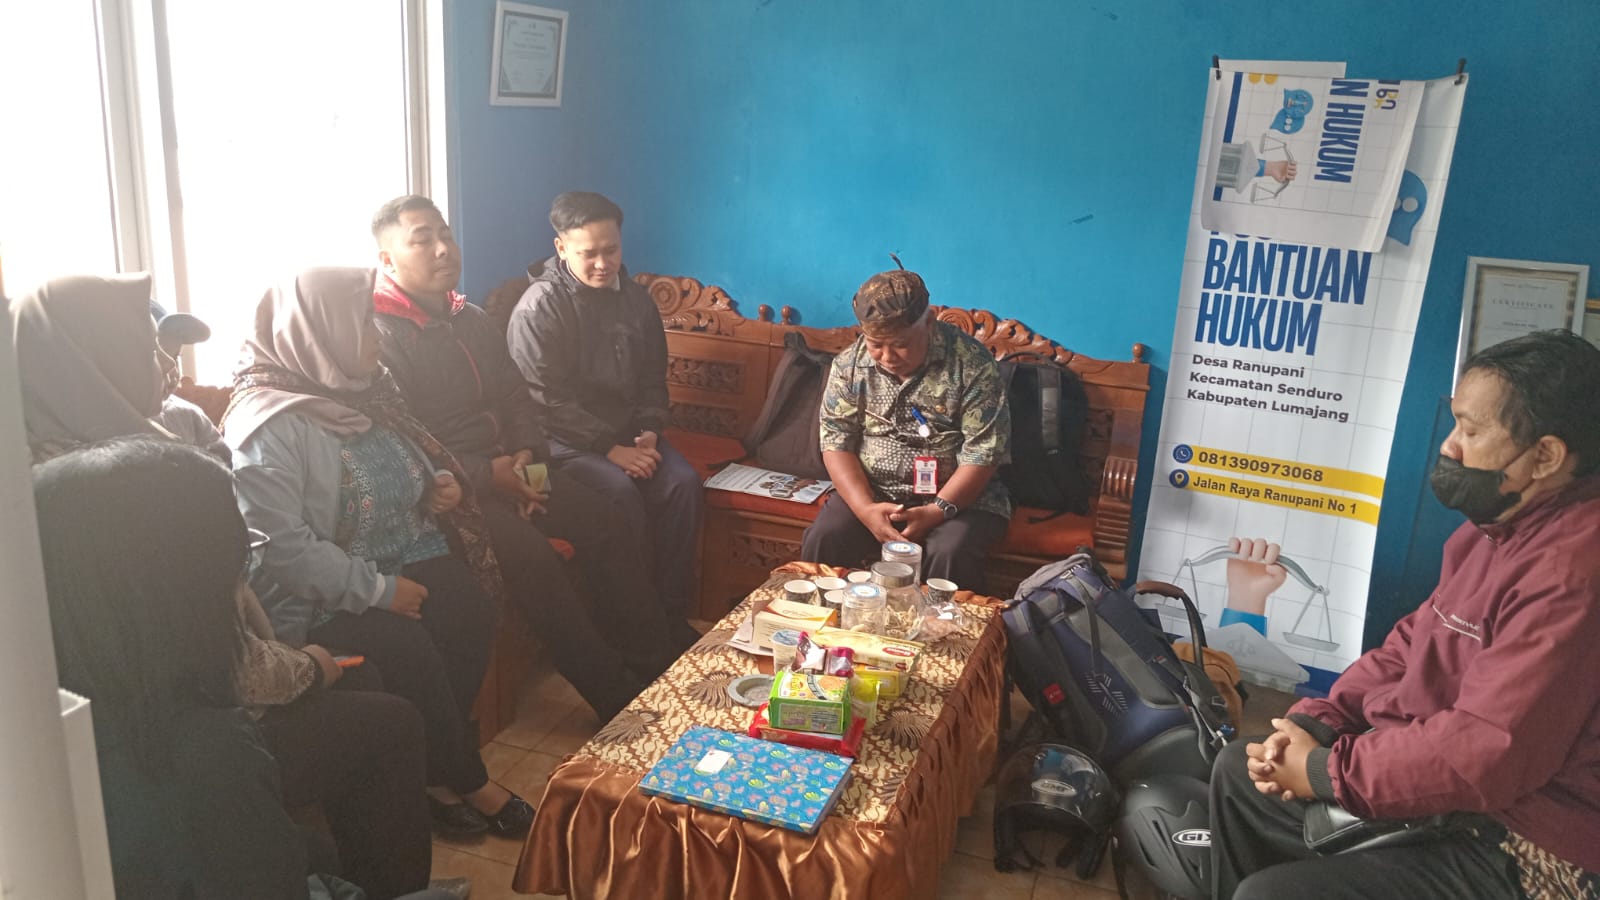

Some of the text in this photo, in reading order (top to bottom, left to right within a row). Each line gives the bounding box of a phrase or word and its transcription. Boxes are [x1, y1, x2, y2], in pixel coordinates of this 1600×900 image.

[1314, 102, 1366, 184] HUKUM
[1202, 238, 1372, 305] BANTUAN
[1194, 292, 1323, 356] HUKUM
[1192, 354, 1305, 379] Desa Ranupani
[1189, 371, 1343, 402] Kecamatan Senduro
[1187, 388, 1350, 423] Kabupaten Lumajang
[1198, 451, 1324, 482] 081390973068
[1193, 476, 1357, 514] Jalan Raya Ranupani No 1
